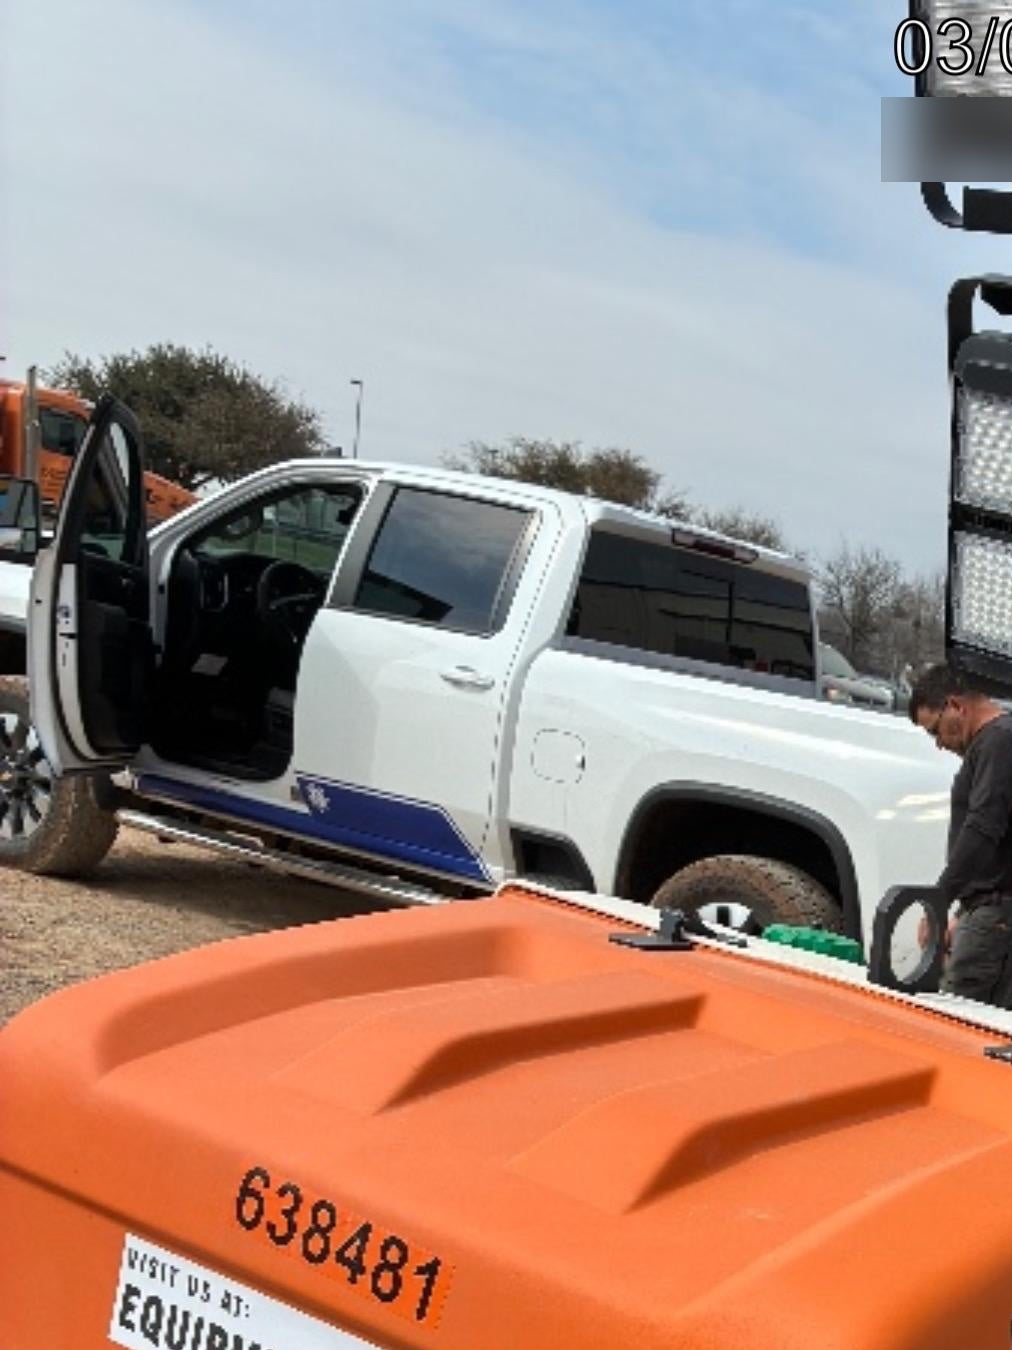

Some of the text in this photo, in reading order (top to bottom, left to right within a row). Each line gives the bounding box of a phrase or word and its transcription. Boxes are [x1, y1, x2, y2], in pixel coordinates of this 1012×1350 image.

[128, 1248, 250, 1319] VISIT US AT:
[235, 1166, 443, 1322] 638481
